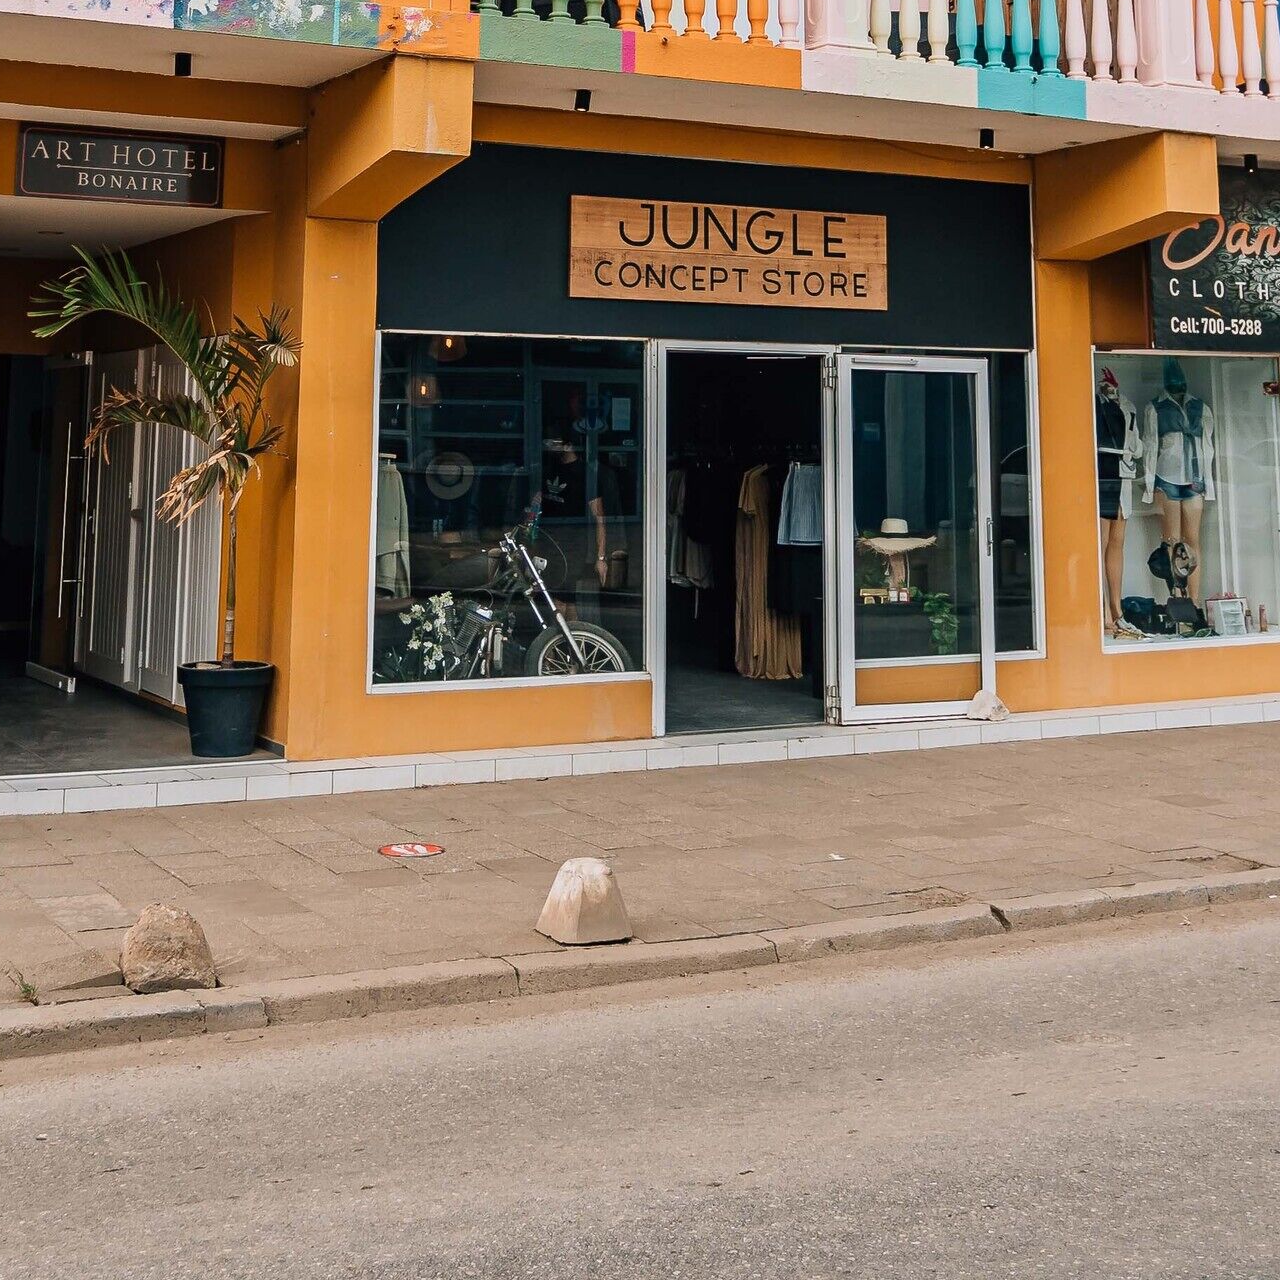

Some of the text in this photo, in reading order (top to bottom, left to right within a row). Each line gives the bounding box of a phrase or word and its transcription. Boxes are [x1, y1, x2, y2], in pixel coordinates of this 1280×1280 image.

[31, 139, 215, 171] ART HOTEL
[77, 172, 177, 193] BONAIRE
[619, 203, 847, 259] JUNGLE
[594, 260, 868, 298] CONCEPT STORE
[1170, 316, 1263, 336] Cell: 700-5288
